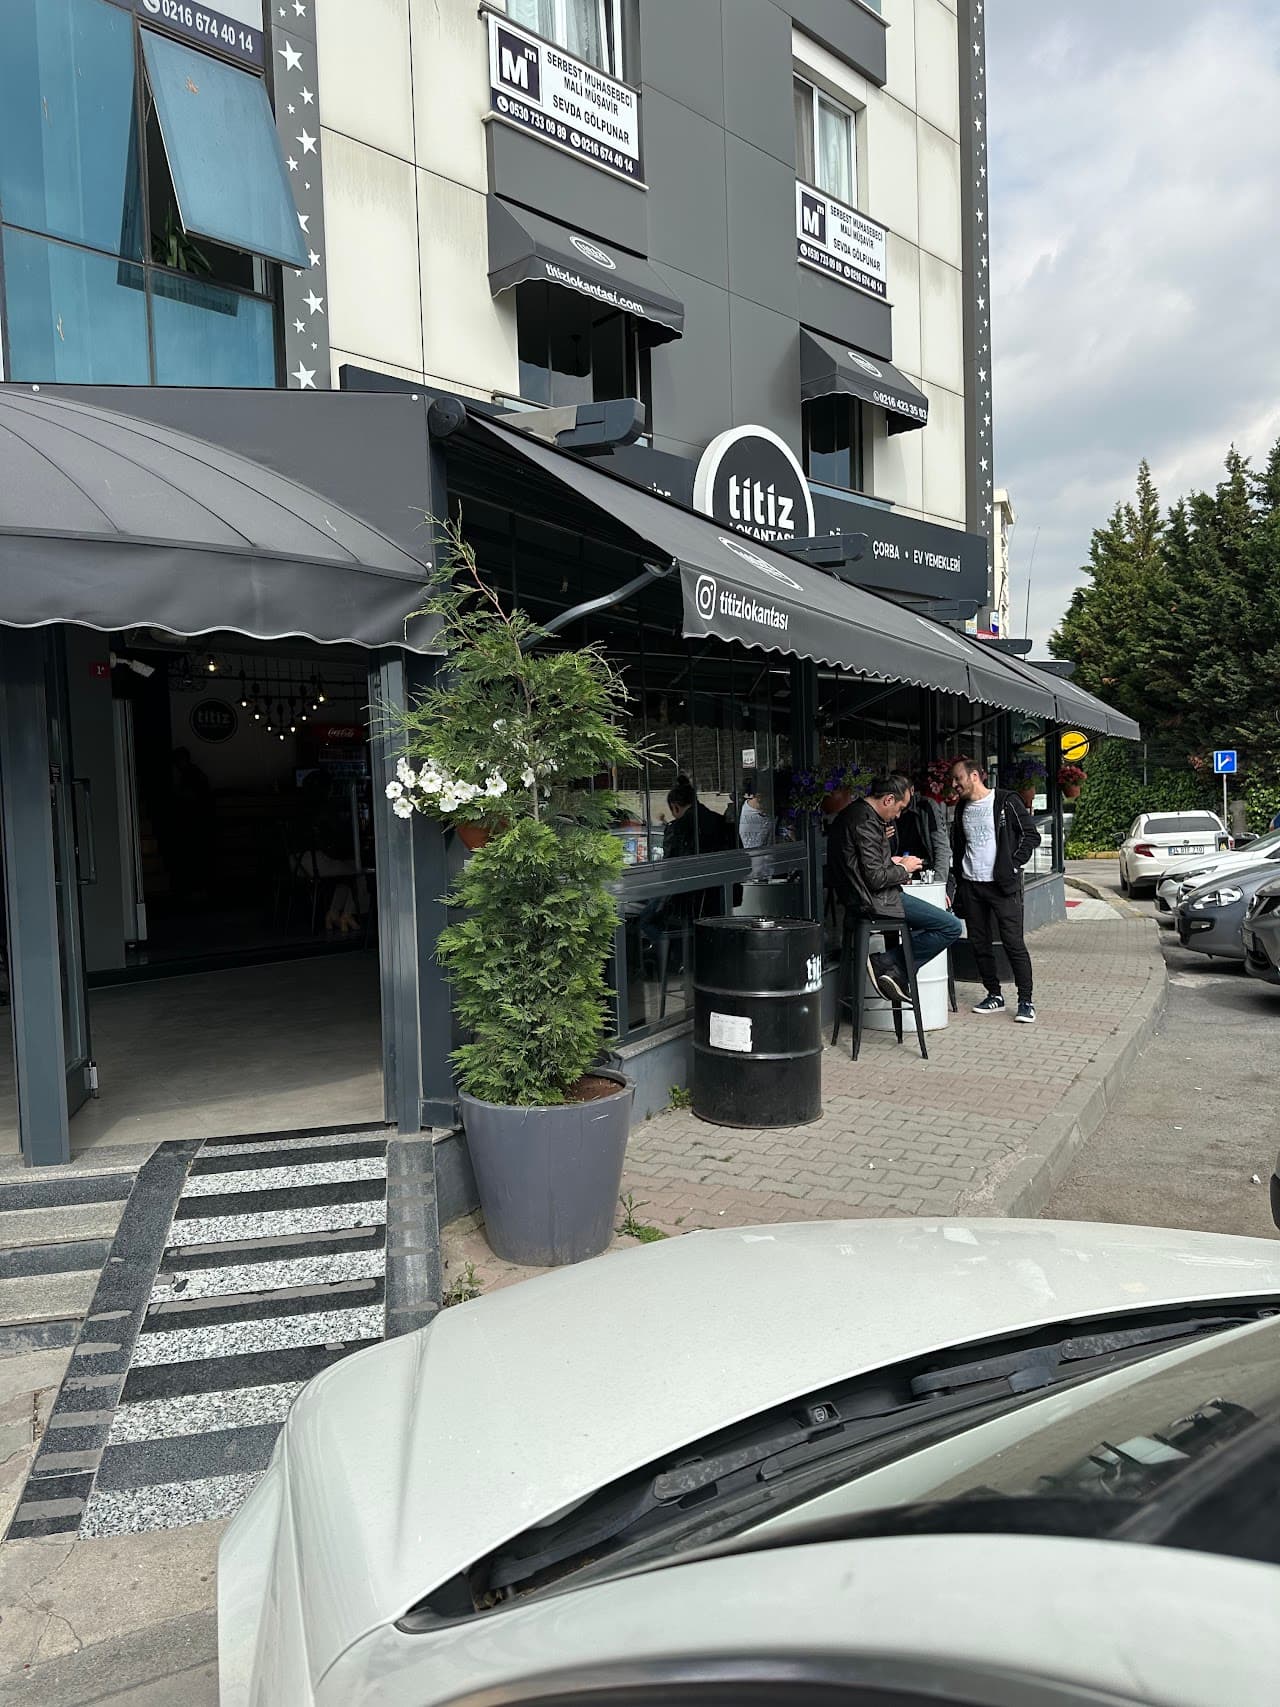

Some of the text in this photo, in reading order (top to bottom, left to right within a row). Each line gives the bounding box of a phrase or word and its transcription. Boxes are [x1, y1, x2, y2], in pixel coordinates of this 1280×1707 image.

[162, 0, 253, 53] 0216 674 40 14
[547, 51, 633, 109] SERBEST MUHASEBECİ
[564, 76, 619, 117] MALİ MÜŞAVİR
[509, 101, 633, 173] 0530 733 09 89 0216 674 40 14
[553, 94, 630, 145] SEVDA GÖLPUNAR
[830, 205, 852, 224] SERBEST
[833, 237, 851, 256] SEVDA
[545, 263, 645, 314] titizlokantasi.com
[879, 392, 896, 408] 0216
[909, 404, 918, 416] 35
[728, 474, 795, 531] titiz
[873, 540, 961, 573] ÇORBA EV YEMEKLERİ
